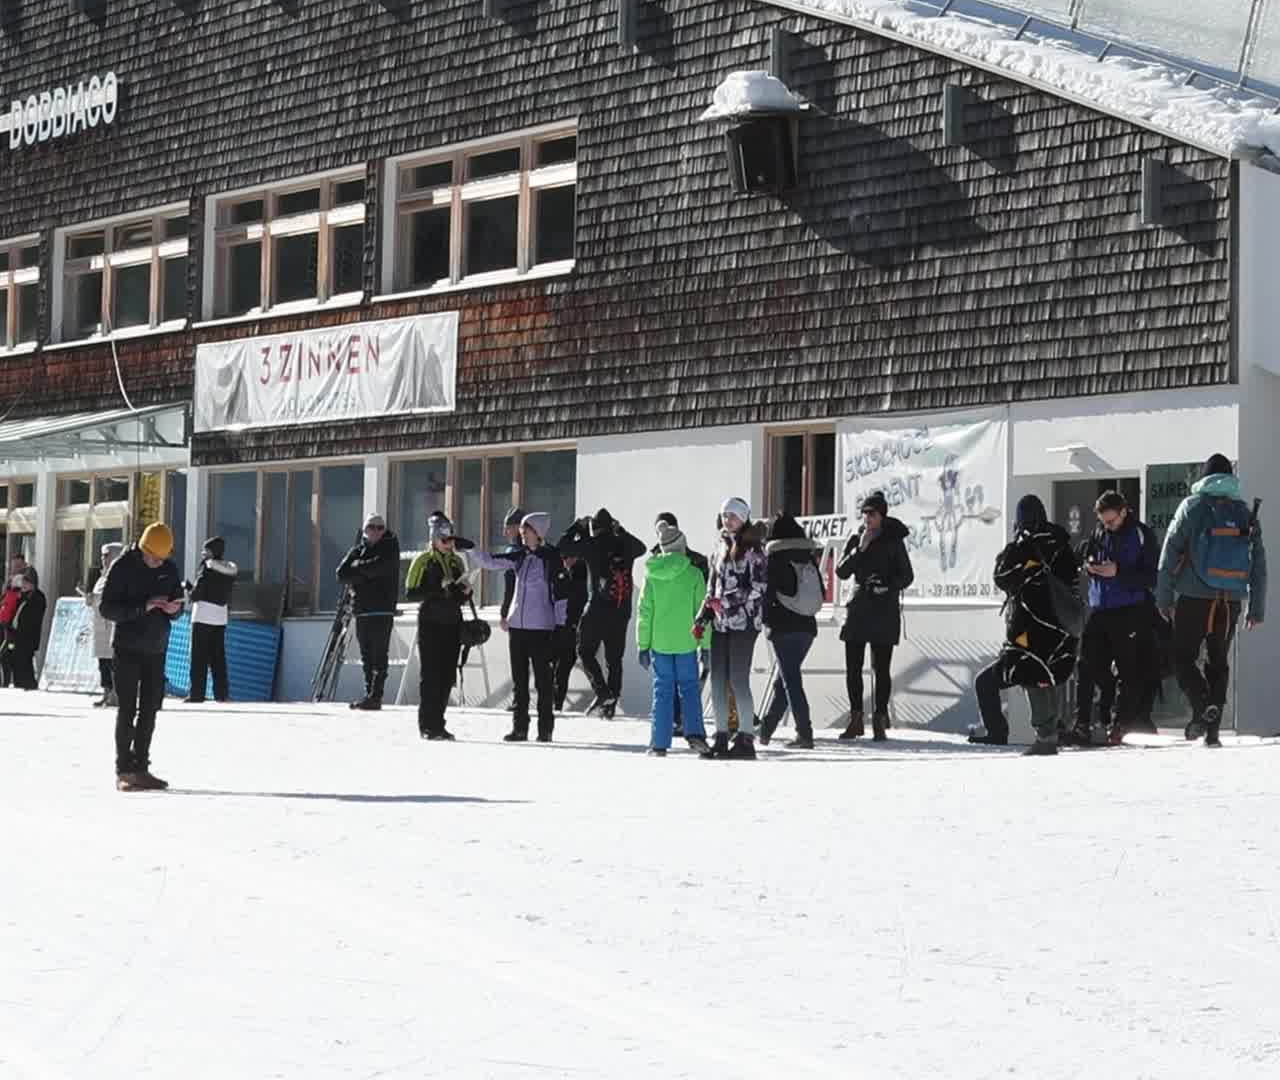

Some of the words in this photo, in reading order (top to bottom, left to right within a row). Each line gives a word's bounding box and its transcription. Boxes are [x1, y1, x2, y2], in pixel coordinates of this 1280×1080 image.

[9, 71, 118, 150] DOBBIACO
[260, 347, 271, 385] 3
[279, 334, 381, 383] ZINNEN
[802, 517, 848, 538] TICKET
